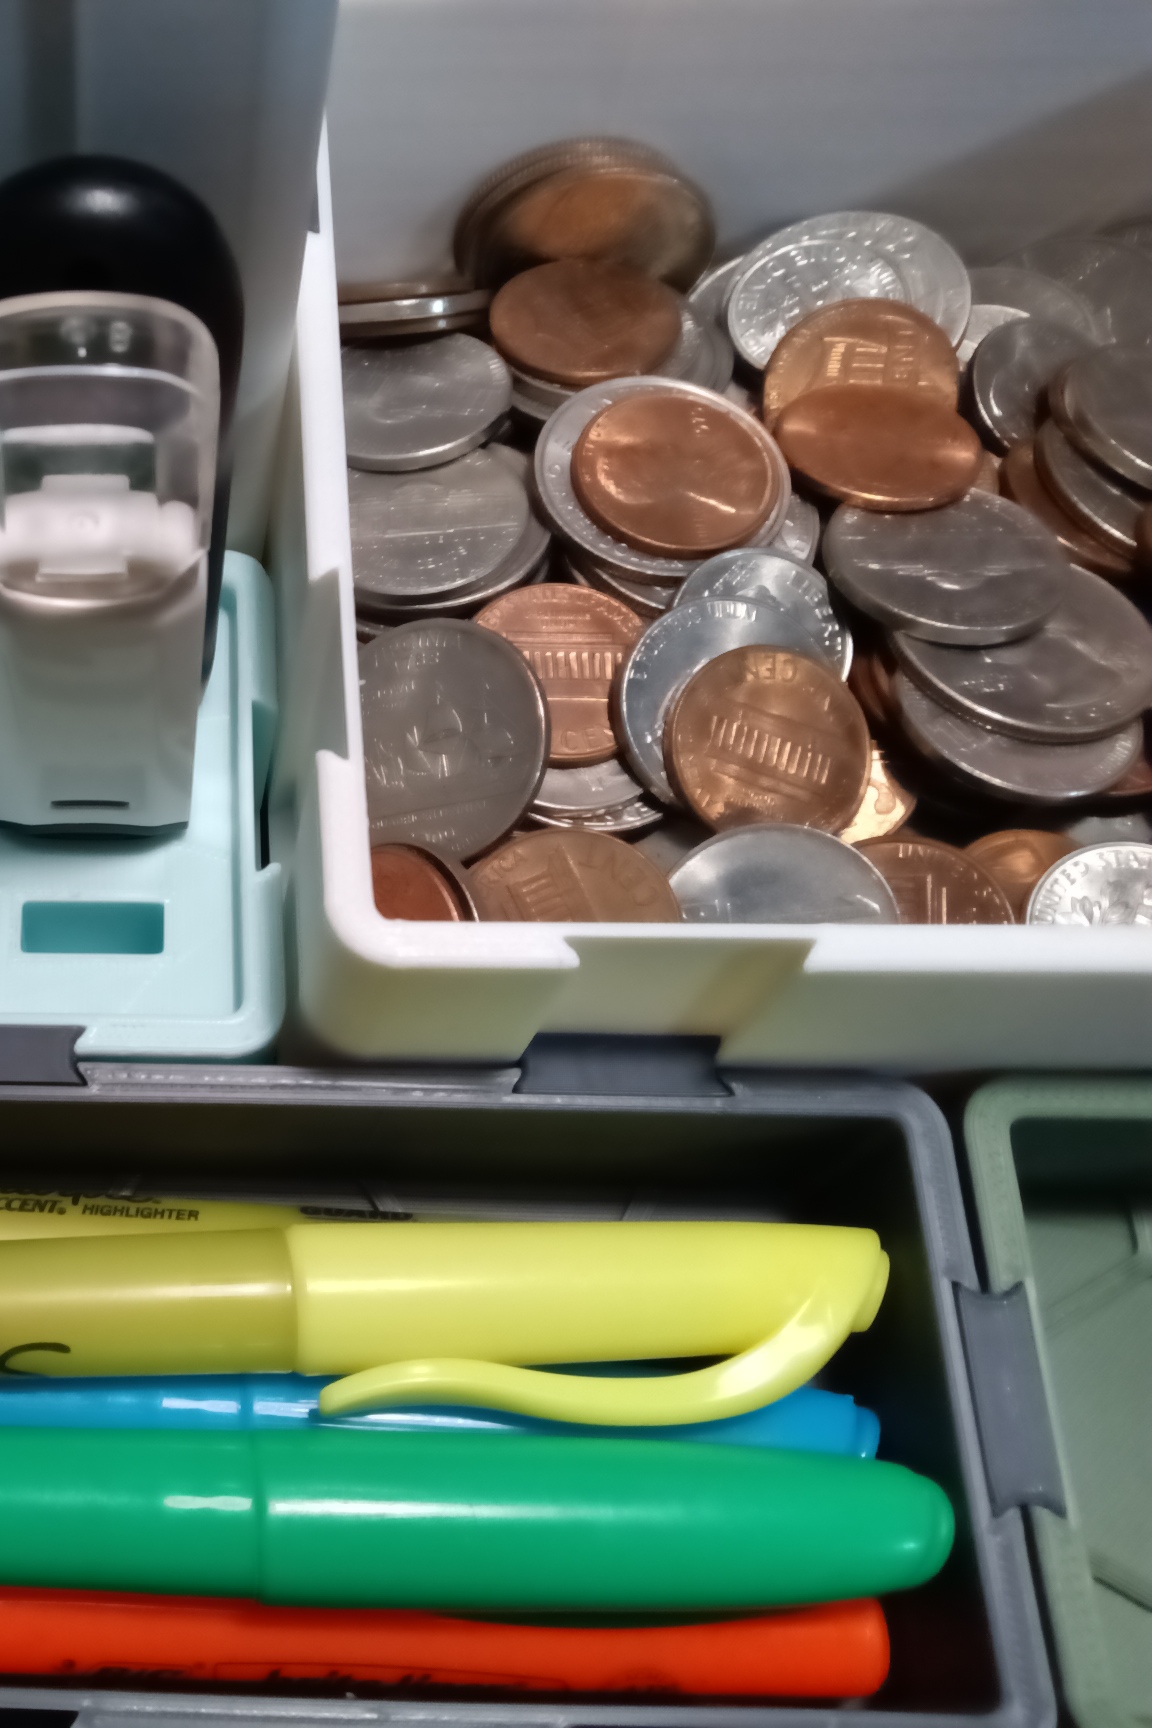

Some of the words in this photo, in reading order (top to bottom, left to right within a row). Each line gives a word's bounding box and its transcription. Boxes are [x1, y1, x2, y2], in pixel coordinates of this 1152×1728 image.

[736, 653, 799, 683] CEN
[561, 726, 616, 751] CEN
[82, 1203, 200, 1221] HIGHLIGHTER
